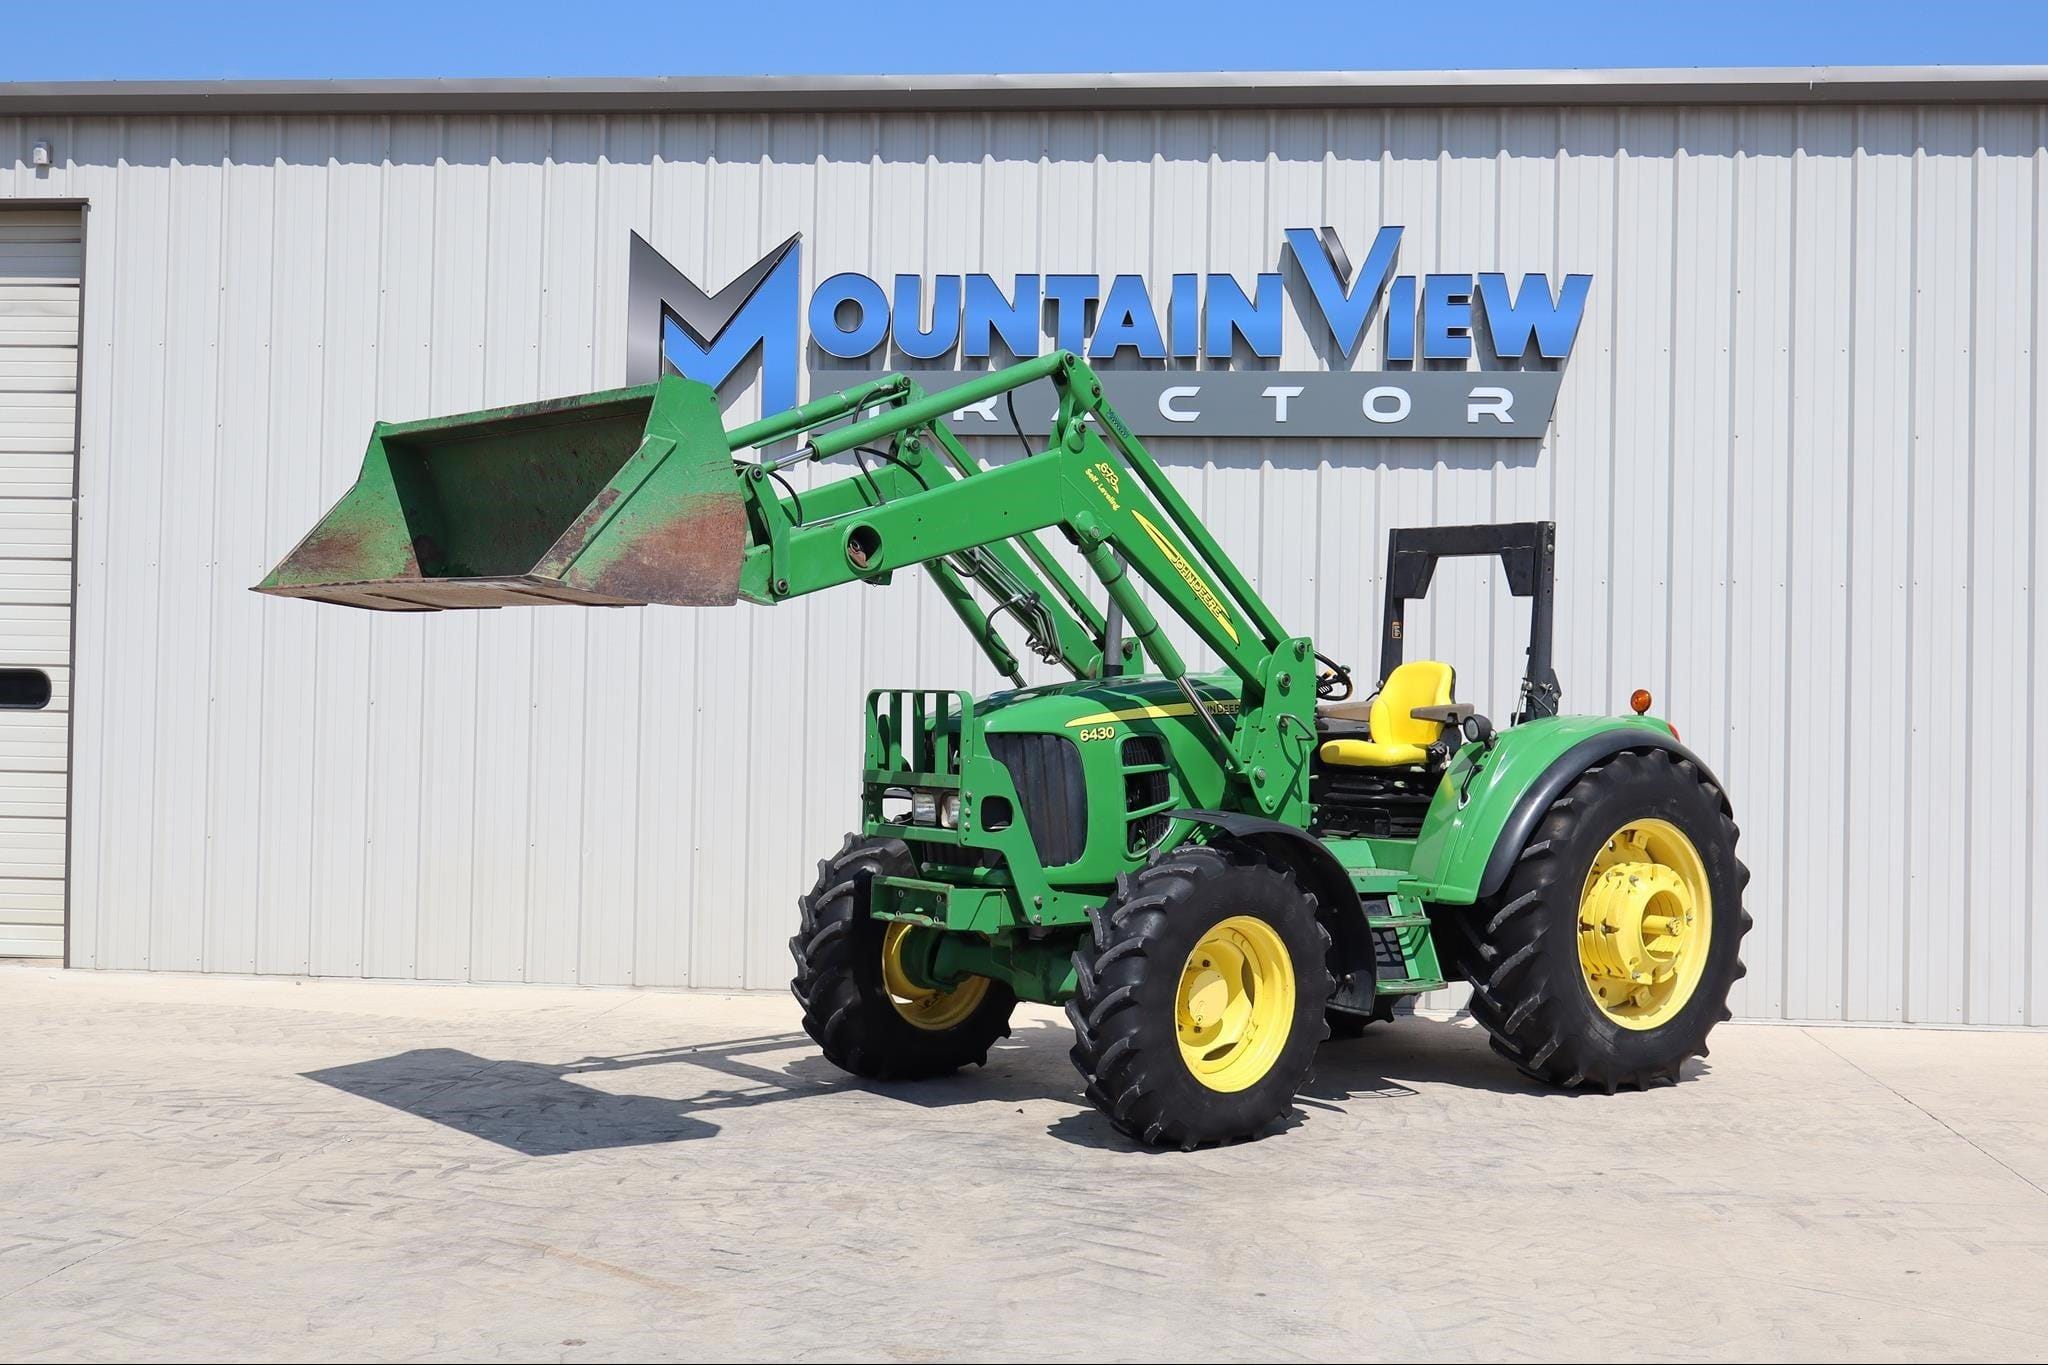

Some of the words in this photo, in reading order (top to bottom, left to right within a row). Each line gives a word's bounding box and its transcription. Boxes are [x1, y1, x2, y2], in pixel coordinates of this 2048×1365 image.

[868, 386, 1516, 423] RCTOR
[1099, 462, 1119, 486] 673
[1217, 703, 1240, 714] DEER
[1080, 727, 1115, 742] 6430
